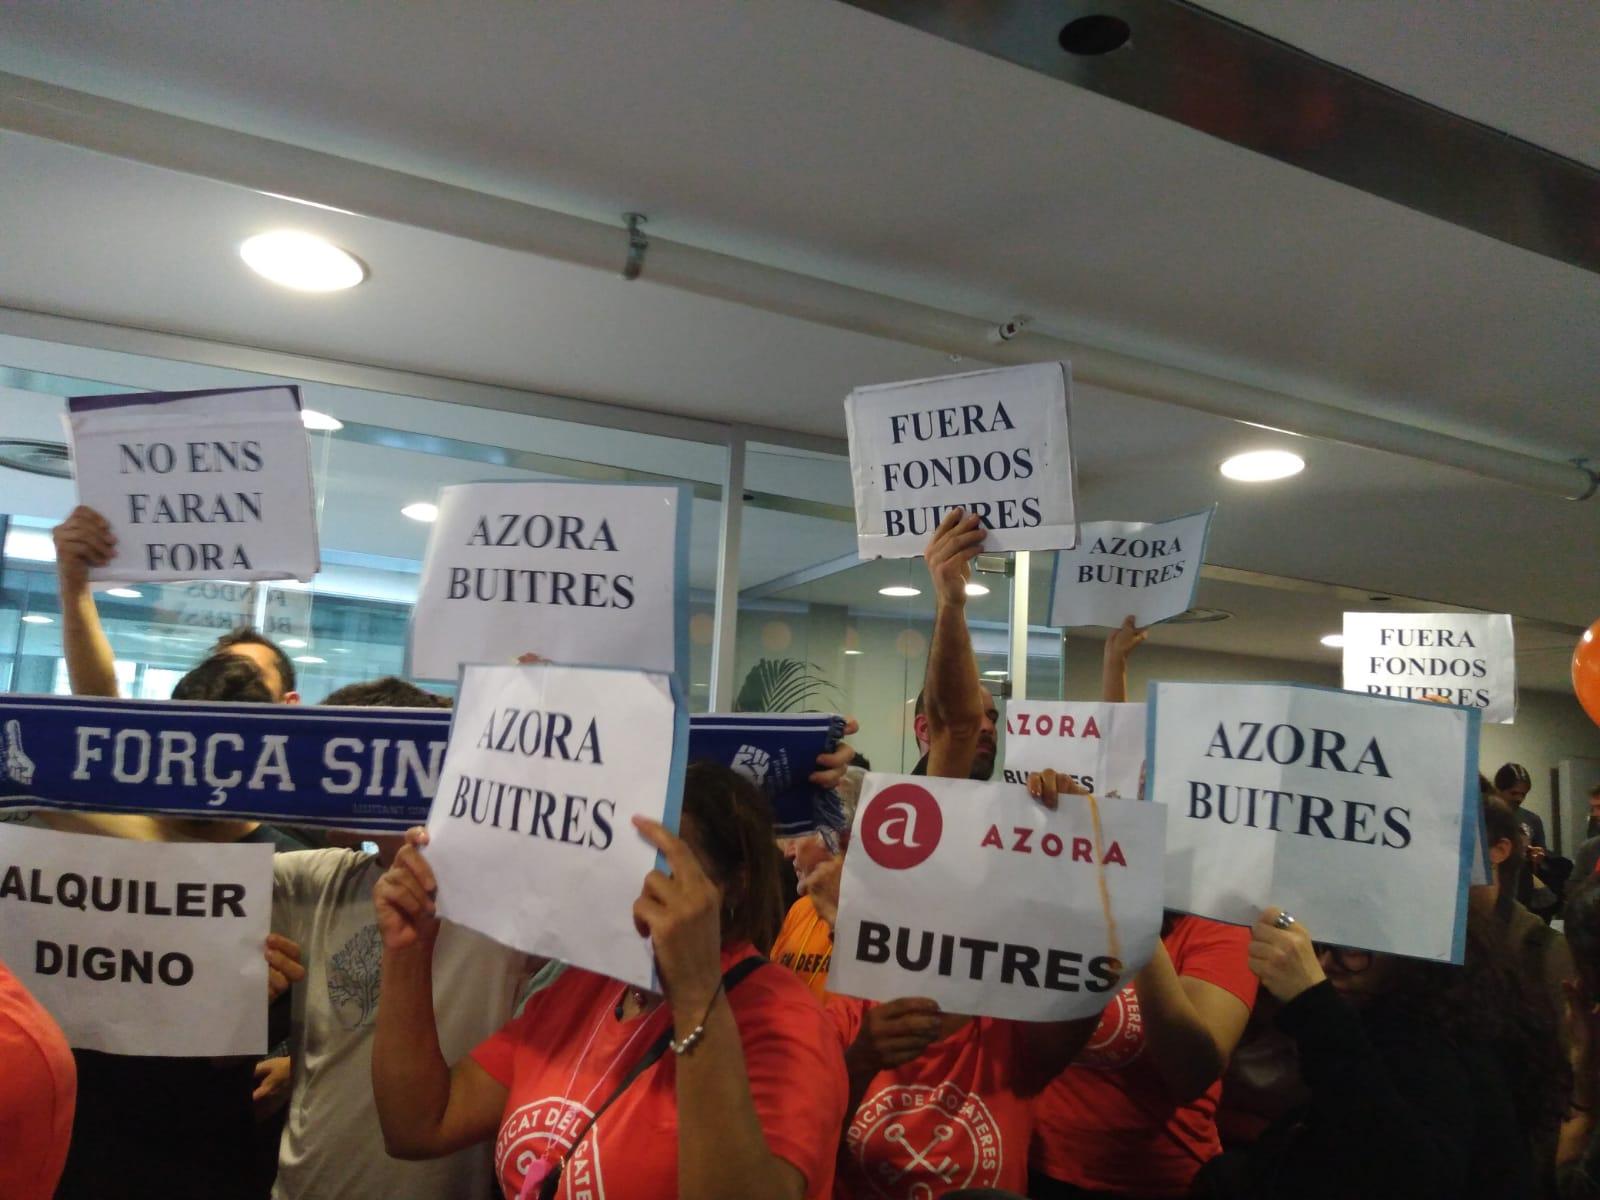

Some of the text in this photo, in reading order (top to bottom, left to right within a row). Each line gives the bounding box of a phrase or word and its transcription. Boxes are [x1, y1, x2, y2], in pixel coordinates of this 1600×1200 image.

[889, 400, 1016, 445] FUERA
[119, 440, 264, 474] NO ENS
[882, 448, 1034, 492] FONDOS
[128, 492, 263, 524] FARAN
[466, 513, 619, 552] AZORA
[1089, 536, 1182, 559] AZORA
[145, 543, 253, 572] FORA
[1077, 560, 1185, 589] BUITRES
[447, 566, 635, 610] BUITRES
[1380, 628, 1476, 648] FUERA
[1369, 656, 1487, 678] FONDOS
[476, 707, 604, 765] AZORA
[1204, 720, 1393, 779] AZORA
[72, 726, 295, 806] FORÇA
[321, 737, 448, 798] SIN
[449, 775, 615, 851] BUITRES
[1187, 781, 1413, 850] BUITRES
[980, 824, 1128, 867] AZORA
[0, 865, 246, 917] ALQUILER
[35, 940, 194, 987] DIGNO
[855, 919, 1123, 993] BUITRES
